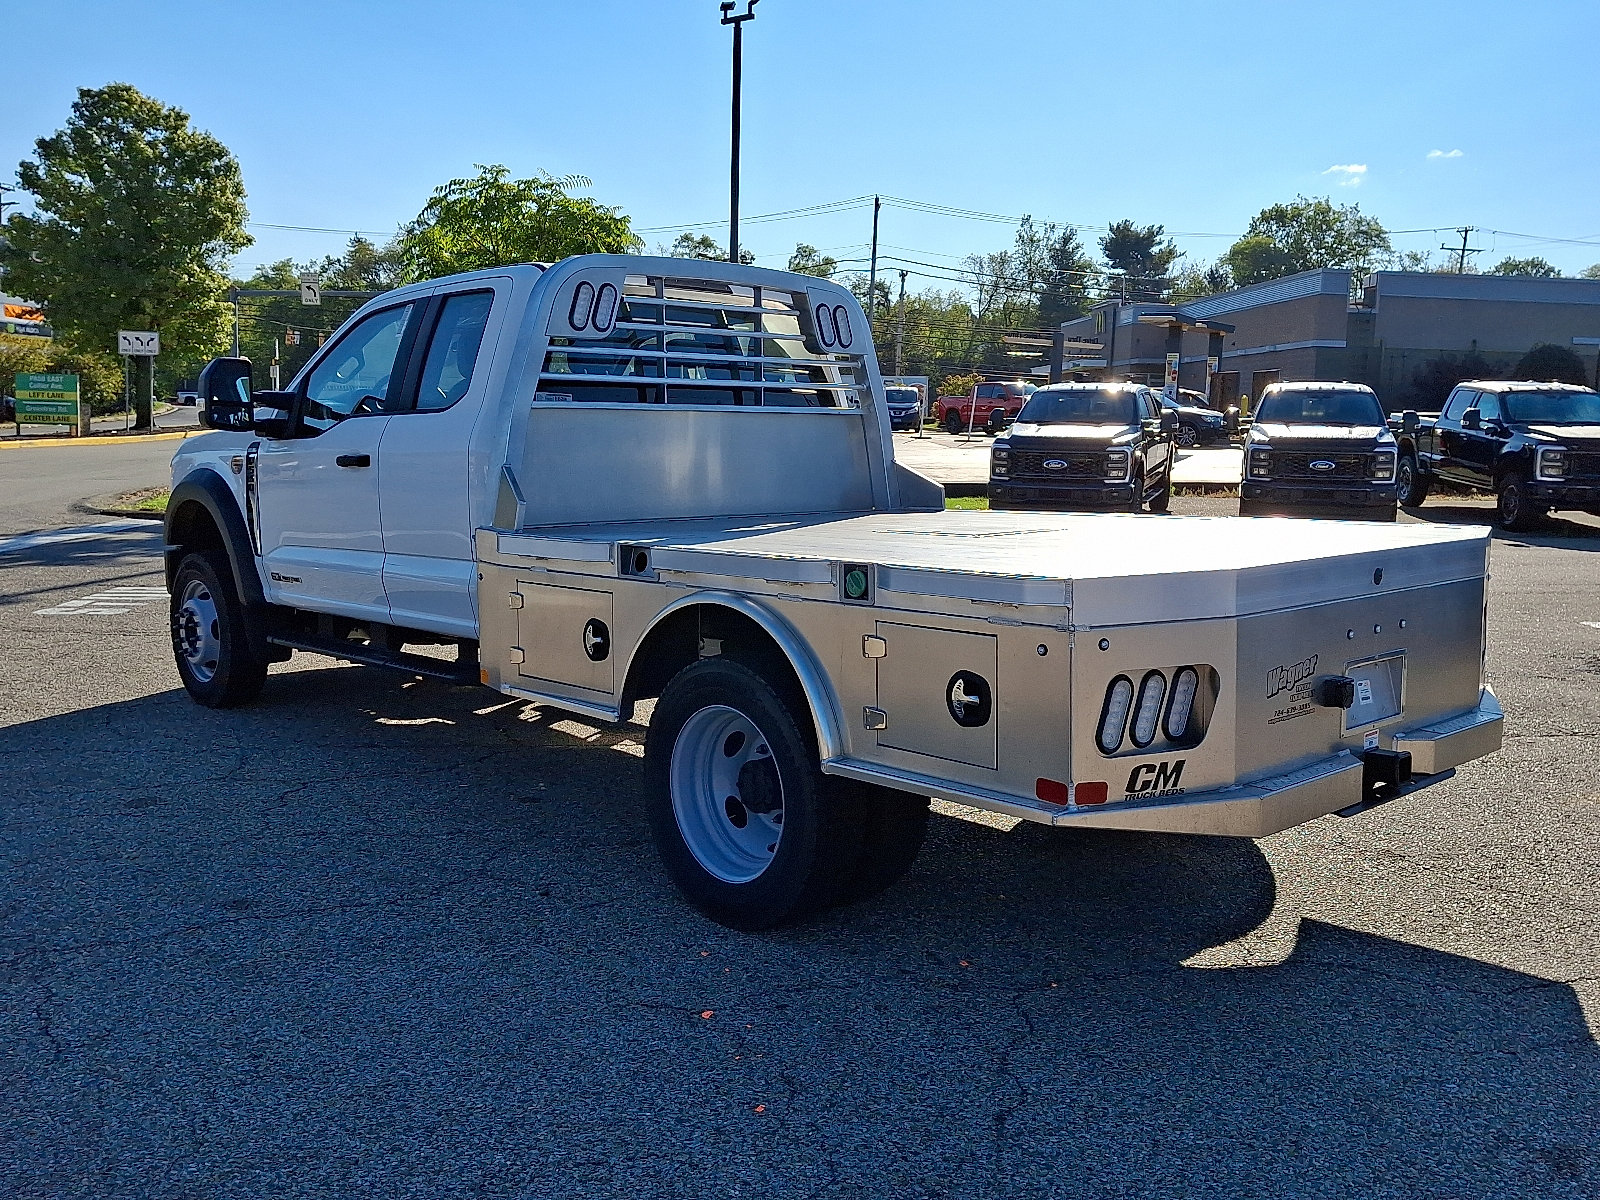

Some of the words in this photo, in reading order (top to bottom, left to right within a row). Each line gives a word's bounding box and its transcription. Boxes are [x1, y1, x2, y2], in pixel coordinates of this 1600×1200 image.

[1267, 654, 1318, 699] Wagner
[1125, 759, 1186, 793] CM
[1124, 791, 1158, 801] TRUCK
[1160, 787, 1185, 796] BEDS
